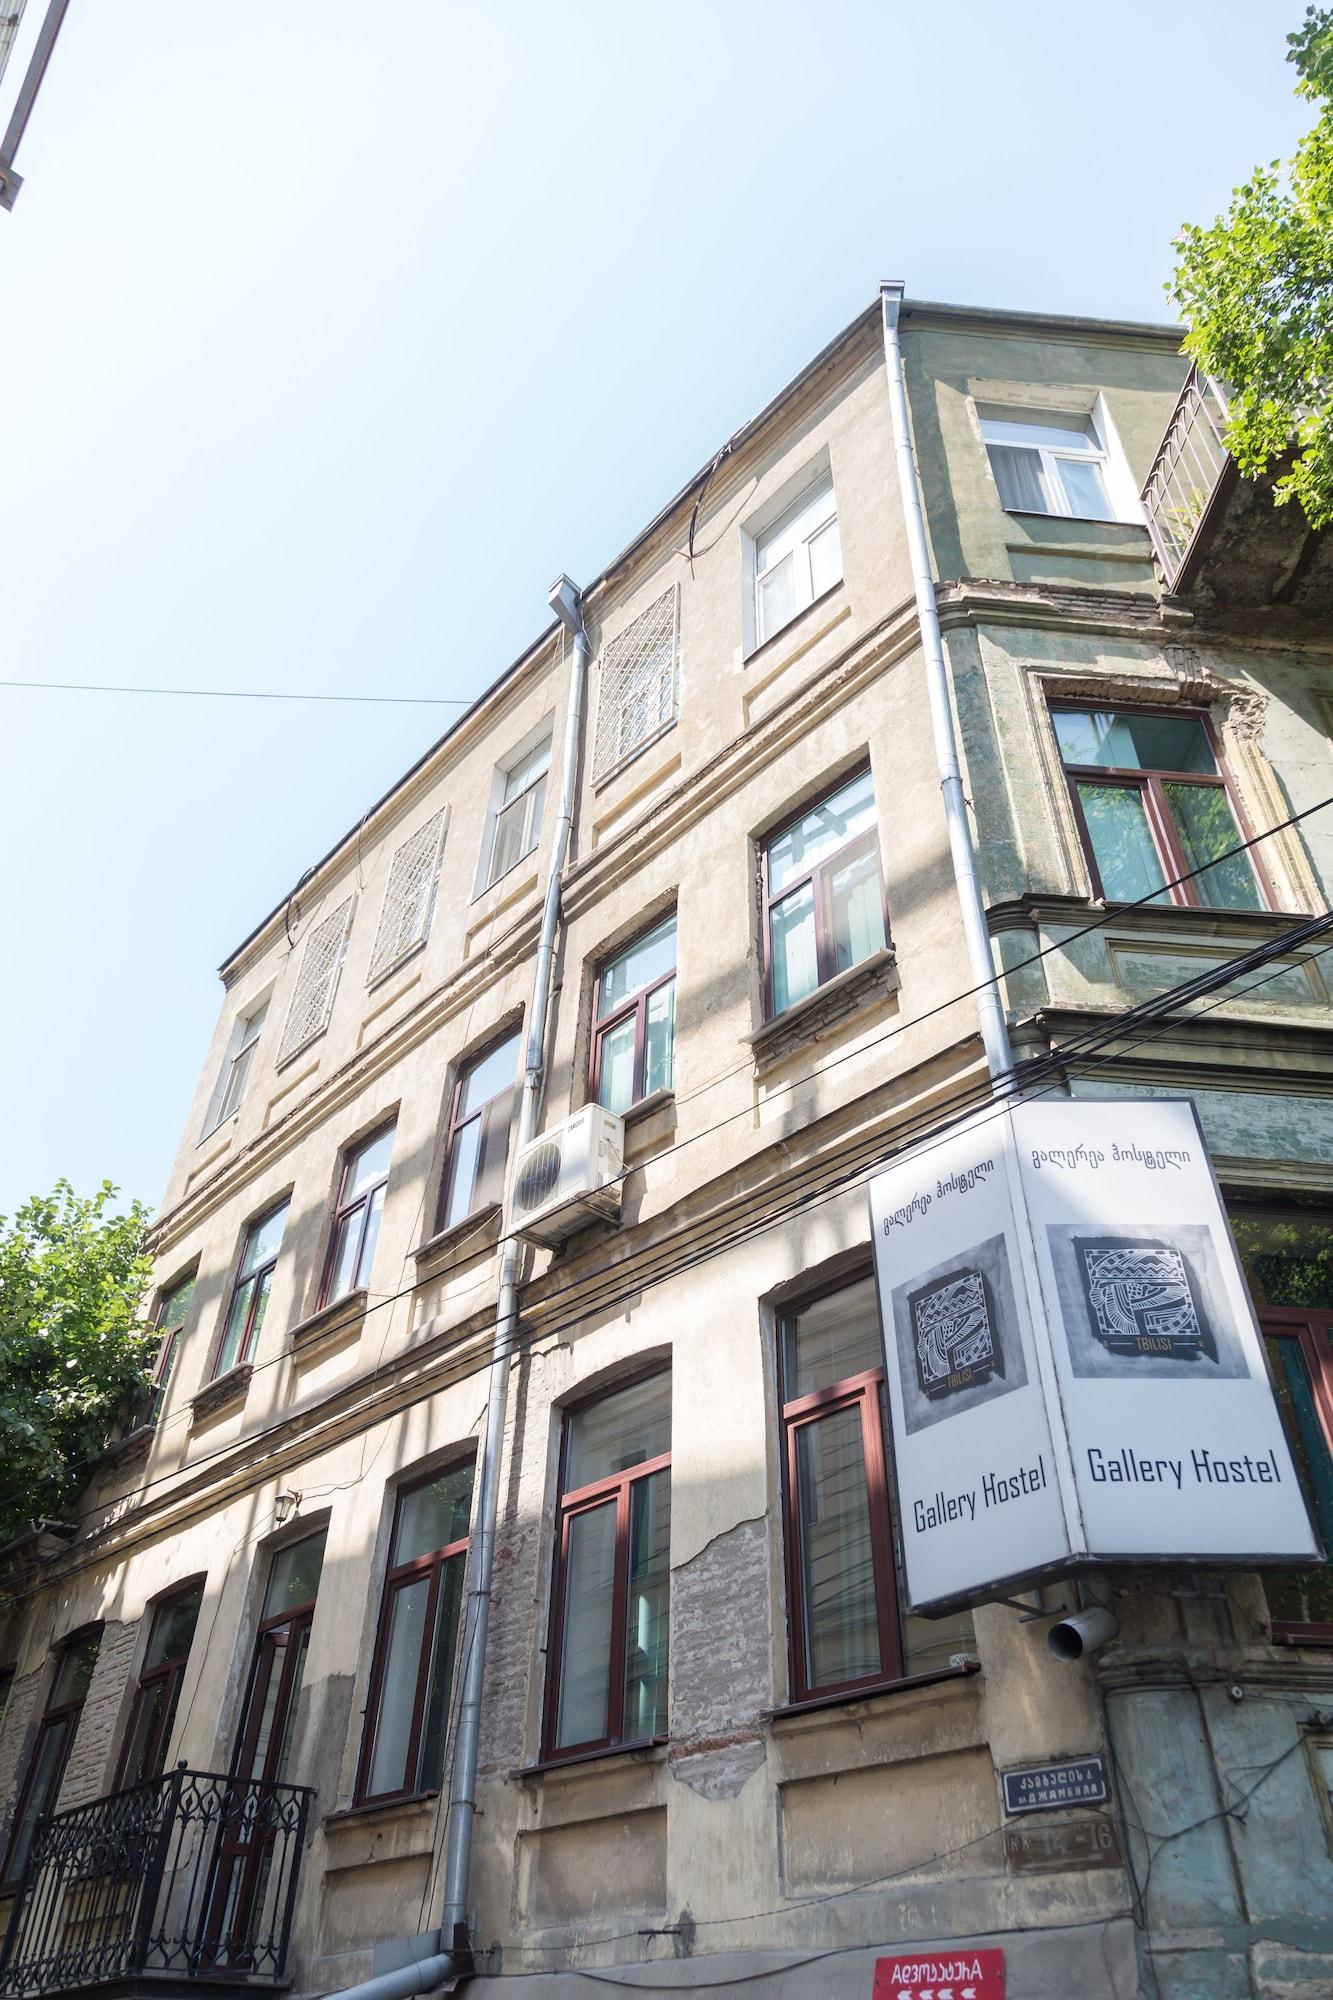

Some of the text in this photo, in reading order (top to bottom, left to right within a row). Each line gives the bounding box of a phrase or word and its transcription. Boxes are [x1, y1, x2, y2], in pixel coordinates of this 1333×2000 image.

[1031, 1142, 1191, 1170] გალერეა ჰოსტელი
[883, 1160, 994, 1236] გალერეა ჰოსტელი
[1135, 1337, 1173, 1351] TBILISI
[947, 1367, 973, 1389] TBILISI
[1087, 1448, 1282, 1490] Gallery Hostel
[913, 1453, 1047, 1533] Gallery Hostel
